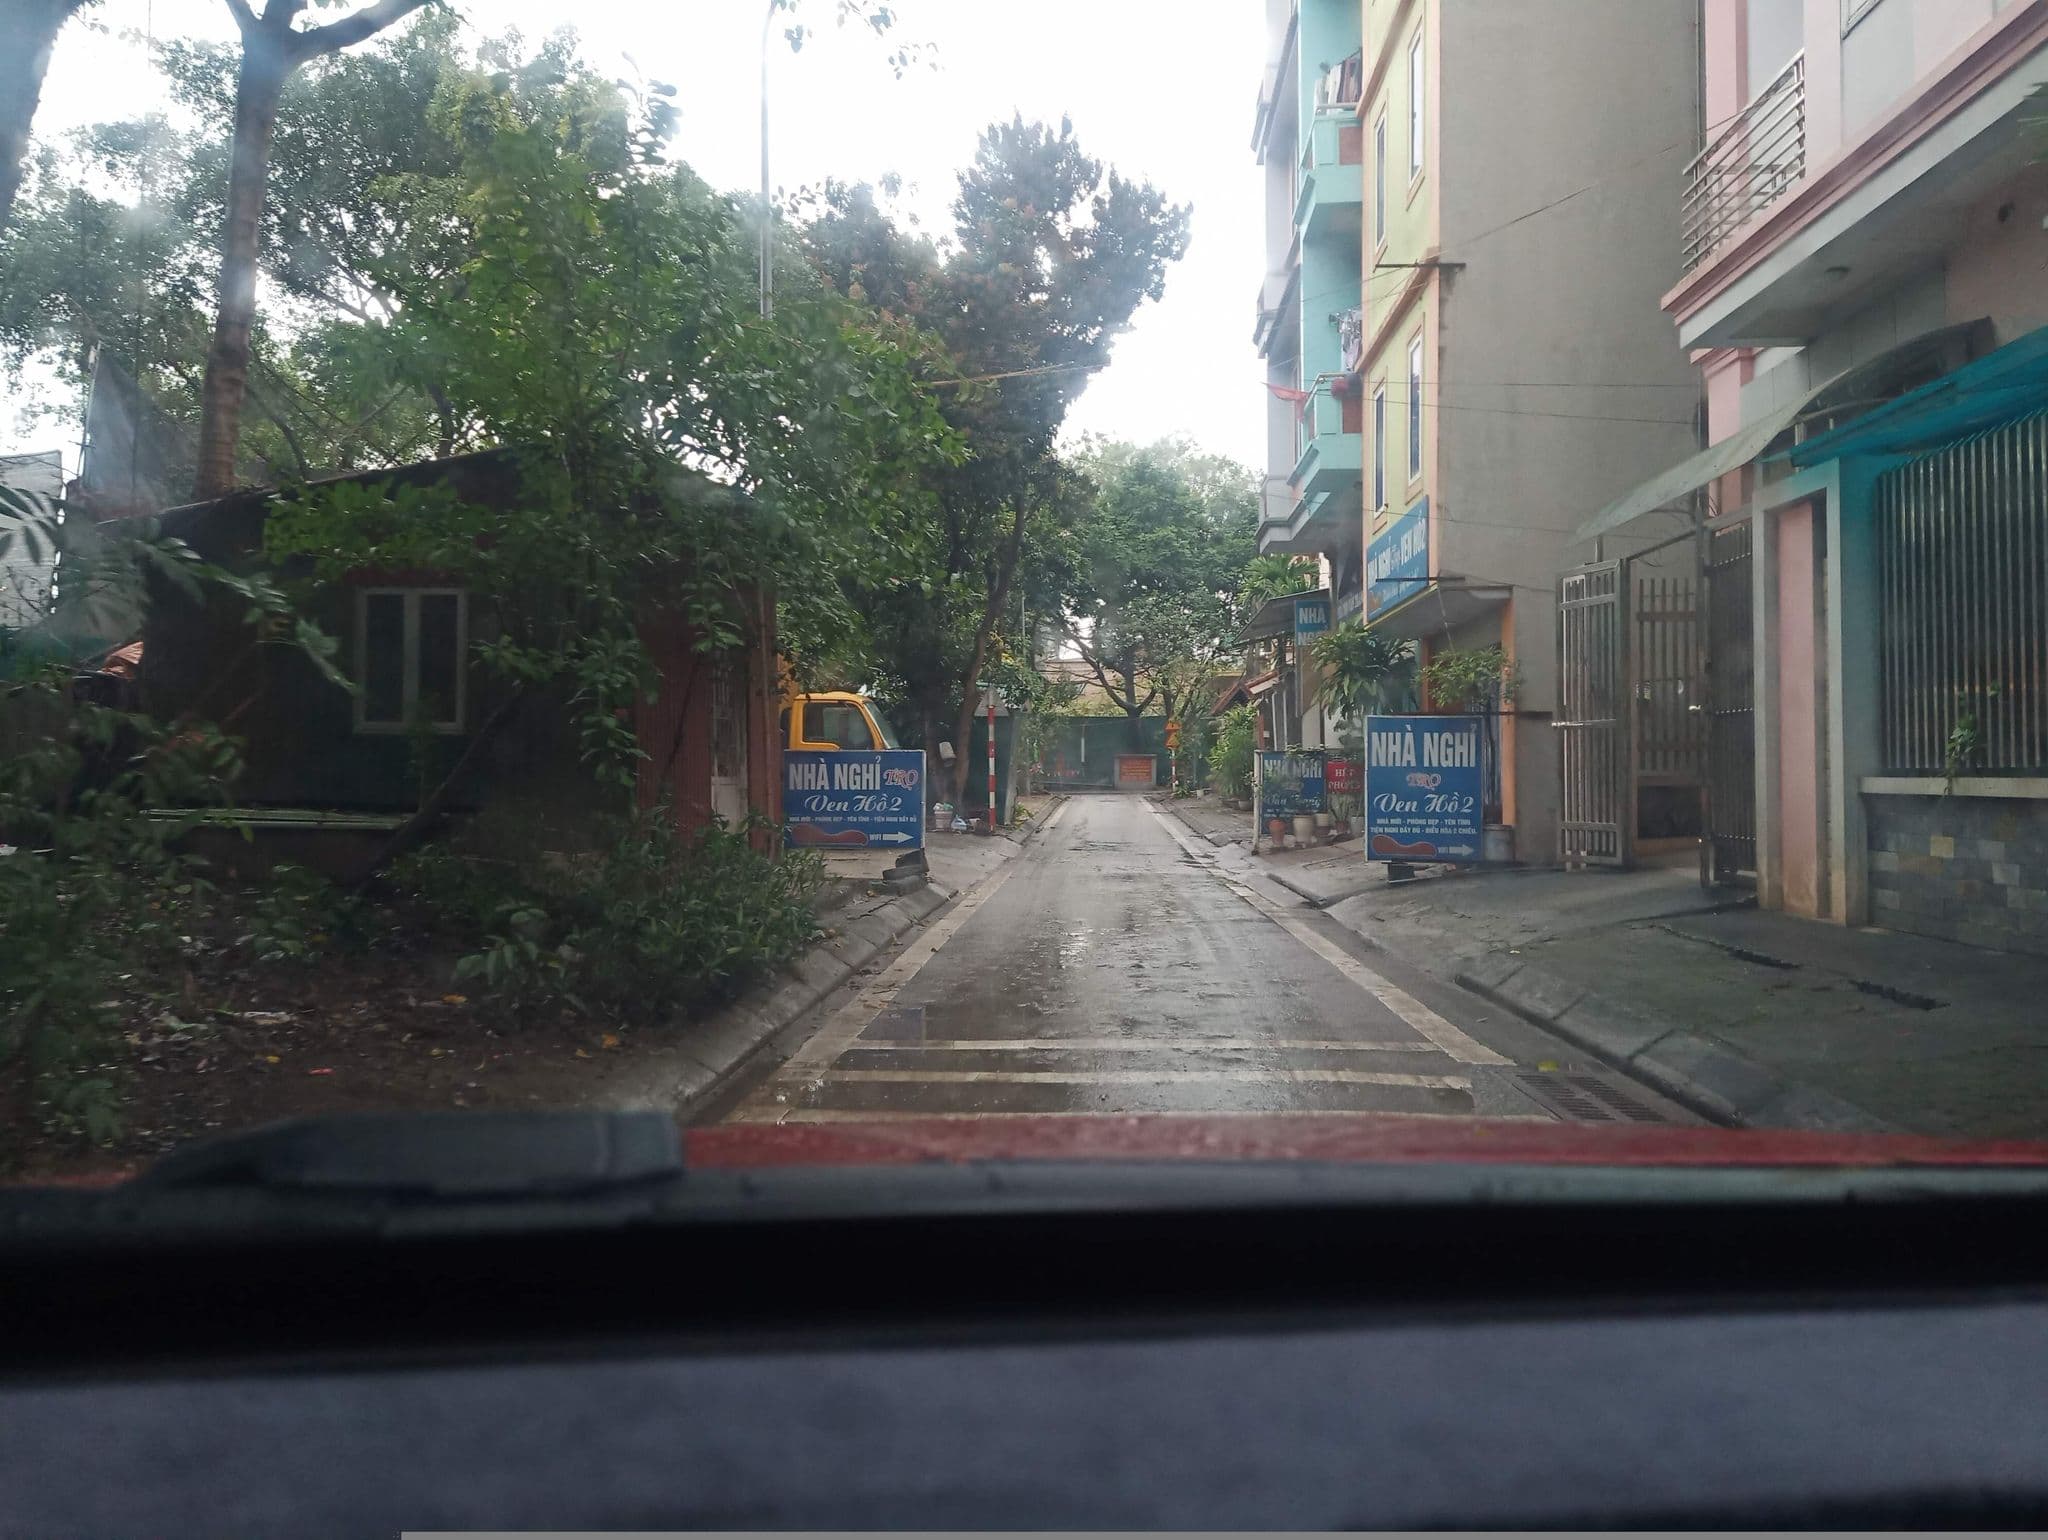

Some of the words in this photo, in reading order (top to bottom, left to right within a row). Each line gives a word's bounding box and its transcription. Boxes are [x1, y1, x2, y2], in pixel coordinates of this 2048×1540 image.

[1371, 724, 1417, 767] NHÀ
[1423, 723, 1477, 767] NGHỈ
[789, 758, 829, 790] NHÀ
[834, 755, 881, 790] NGHỈ
[804, 795, 849, 812] Ven
[1373, 793, 1418, 813] Ven
